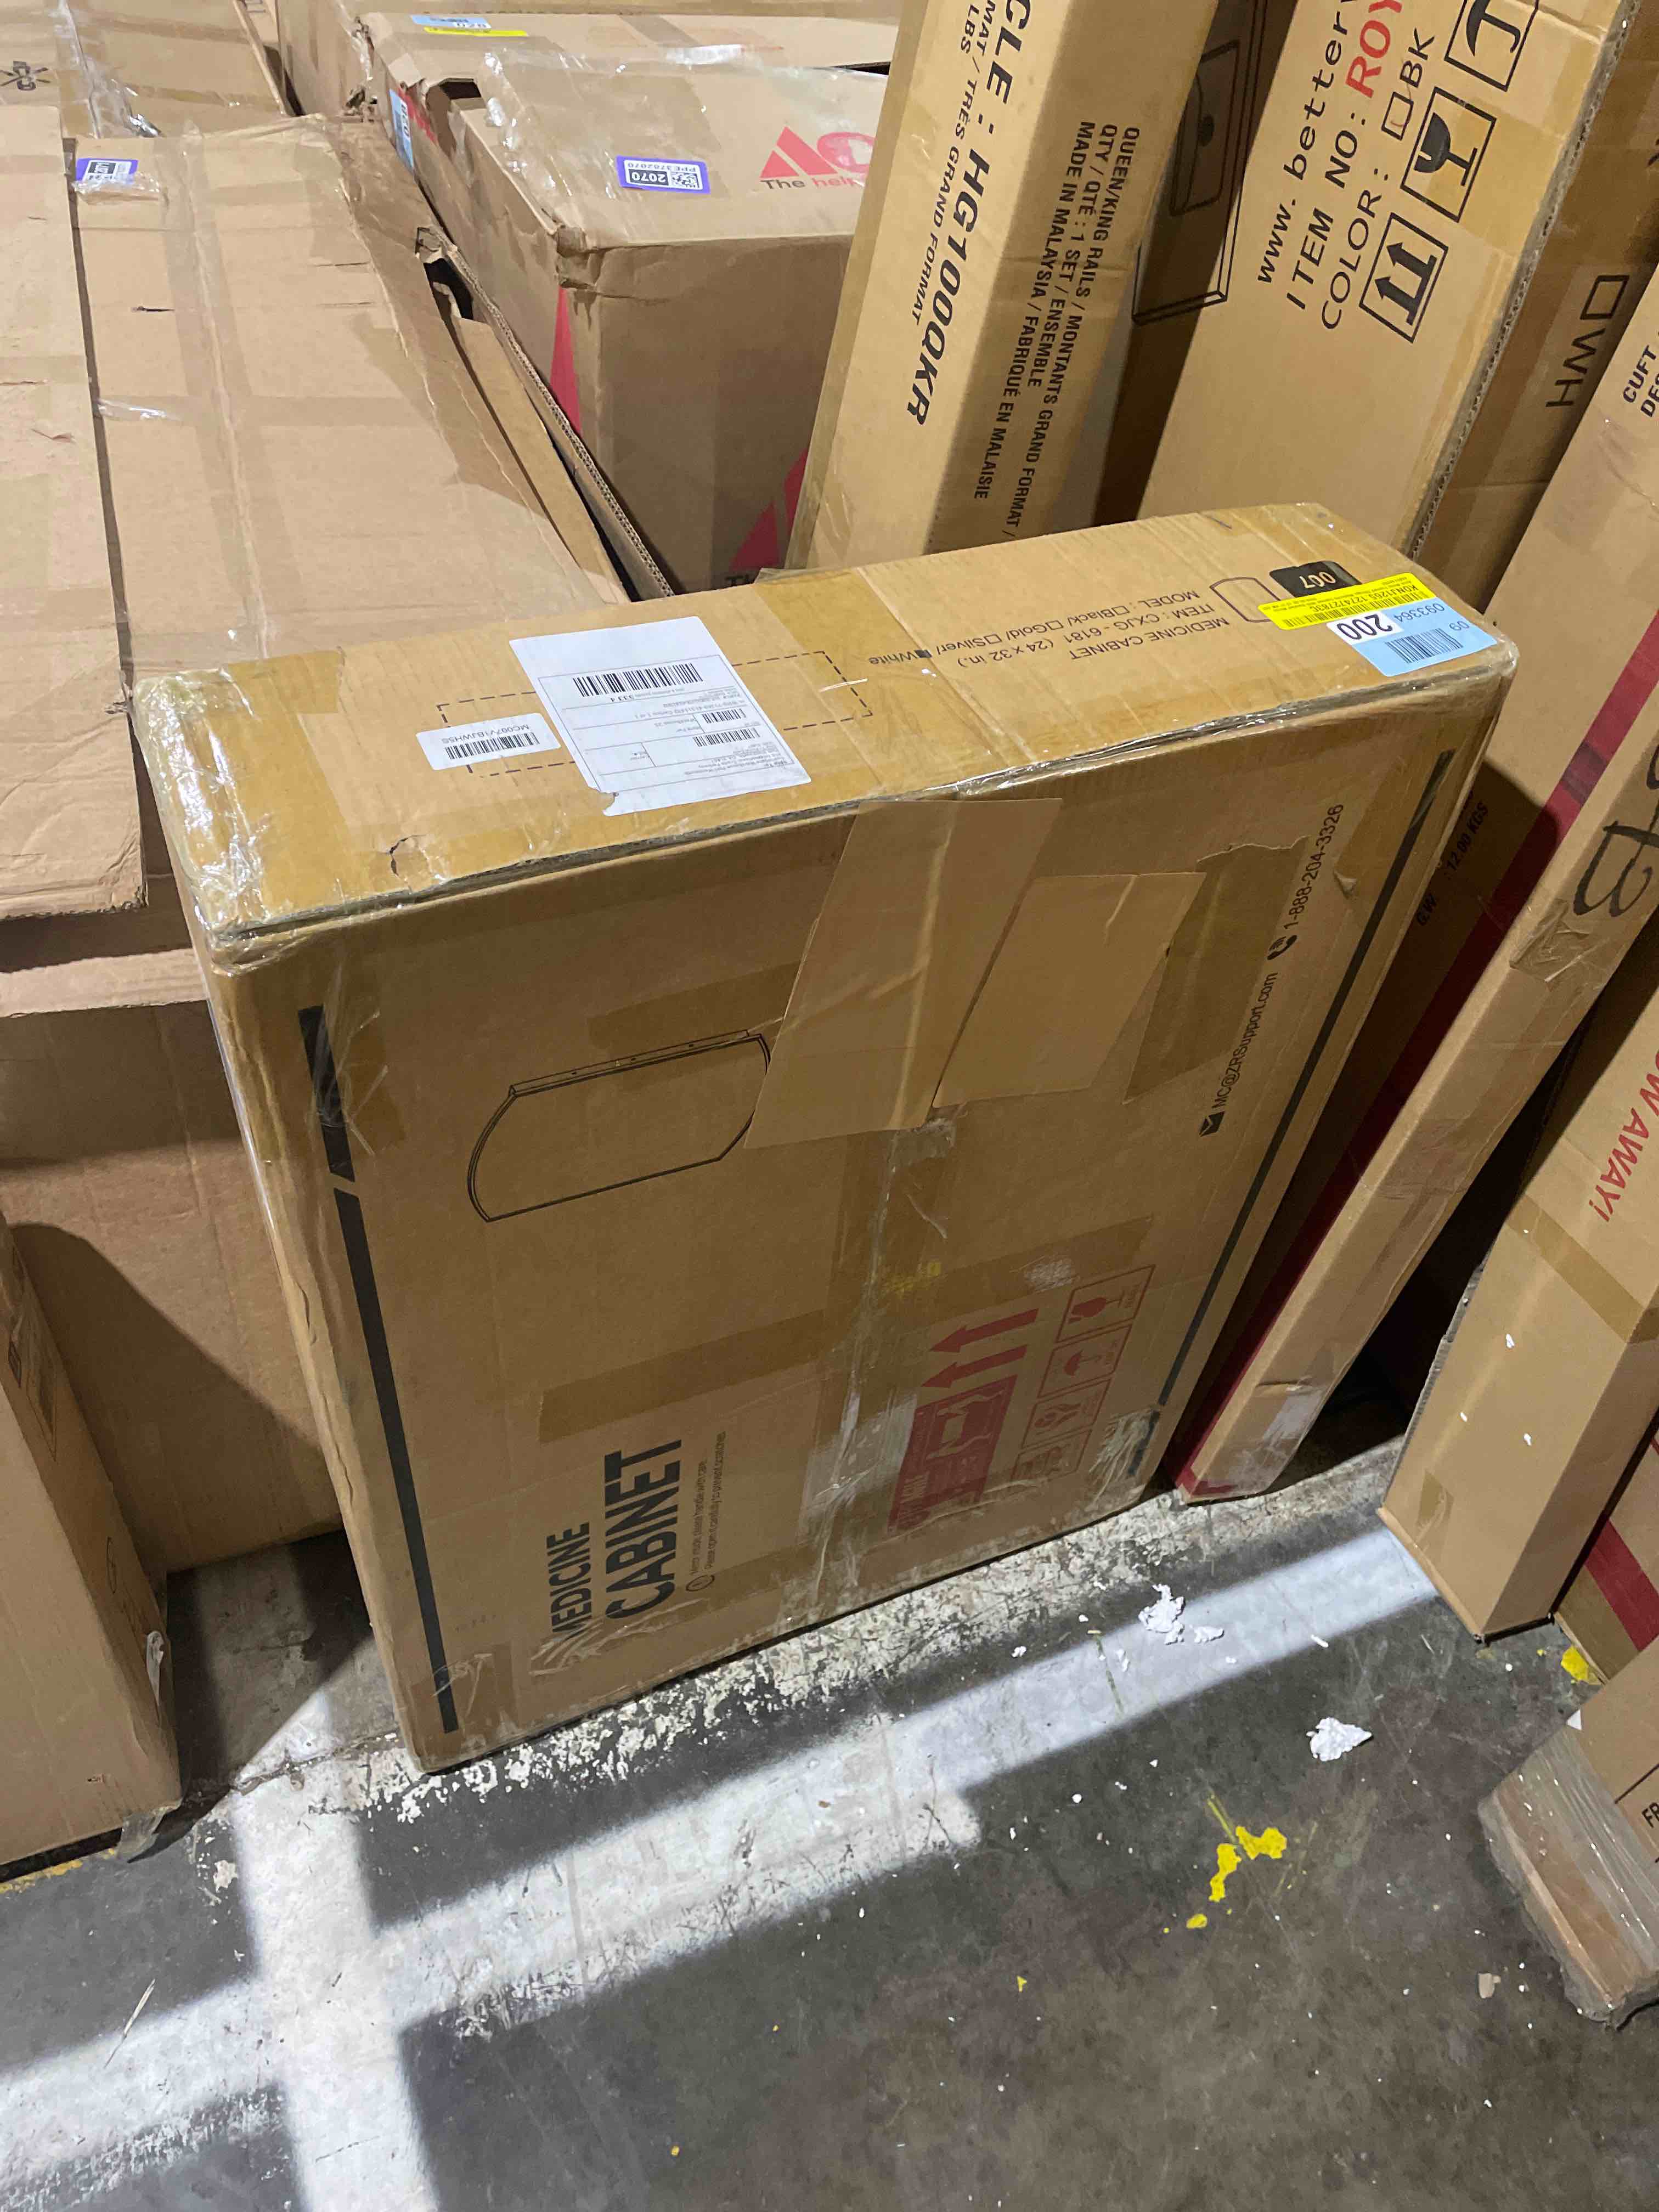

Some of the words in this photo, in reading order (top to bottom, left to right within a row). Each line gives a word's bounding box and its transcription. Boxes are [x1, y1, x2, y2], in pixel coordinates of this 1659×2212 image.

[961, 4, 979, 54] LBS
[1399, 27, 1435, 88] BK
[956, 80, 977, 139] TRÈS
[1066, 122, 1096, 178] MADE
[1095, 124, 1118, 163] QTY
[631, 172, 666, 183] 2070
[760, 179, 806, 189] The
[933, 146, 960, 228] GRAND
[1059, 182, 1077, 202] IN
[1093, 127, 1140, 242] QUEEN/KING
[1031, 208, 1070, 298] MALAYSIA
[1059, 249, 1080, 282] SET
[1075, 247, 1104, 297] RAILS
[1286, 207, 1333, 309] ITEM
[907, 148, 990, 425] HG100QKR
[912, 232, 939, 325] FORMAT
[1003, 315, 1039, 398] FABRIQUÉ
[1028, 298, 1065, 387] ENSEMBLE
[1043, 315, 1082, 404] MONTANTS
[1622, 345, 1657, 403] CUFT
[996, 402, 1014, 422] EN
[1025, 410, 1053, 463] GRAND
[974, 427, 1007, 499] MALAISIE
[1006, 467, 1035, 527] FORMAT
[1138, 590, 1201, 608] MODEL
[1299, 571, 1336, 589] 007
[1063, 627, 1102, 644] 6181
[1144, 617, 1231, 641] MEDICINE
[1171, 603, 1215, 619] ITEM
[1336, 614, 1393, 641] 200
[1393, 603, 1445, 624] 093364
[1449, 620, 1470, 632] 09
[868, 650, 919, 665] White
[989, 649, 1013, 662] 32
[1069, 635, 1144, 660] CABINET
[1588, 1107, 1650, 1222] AWAY!
[546, 1522, 593, 1643] MEDICINE
[605, 1439, 682, 1620] CABINET
